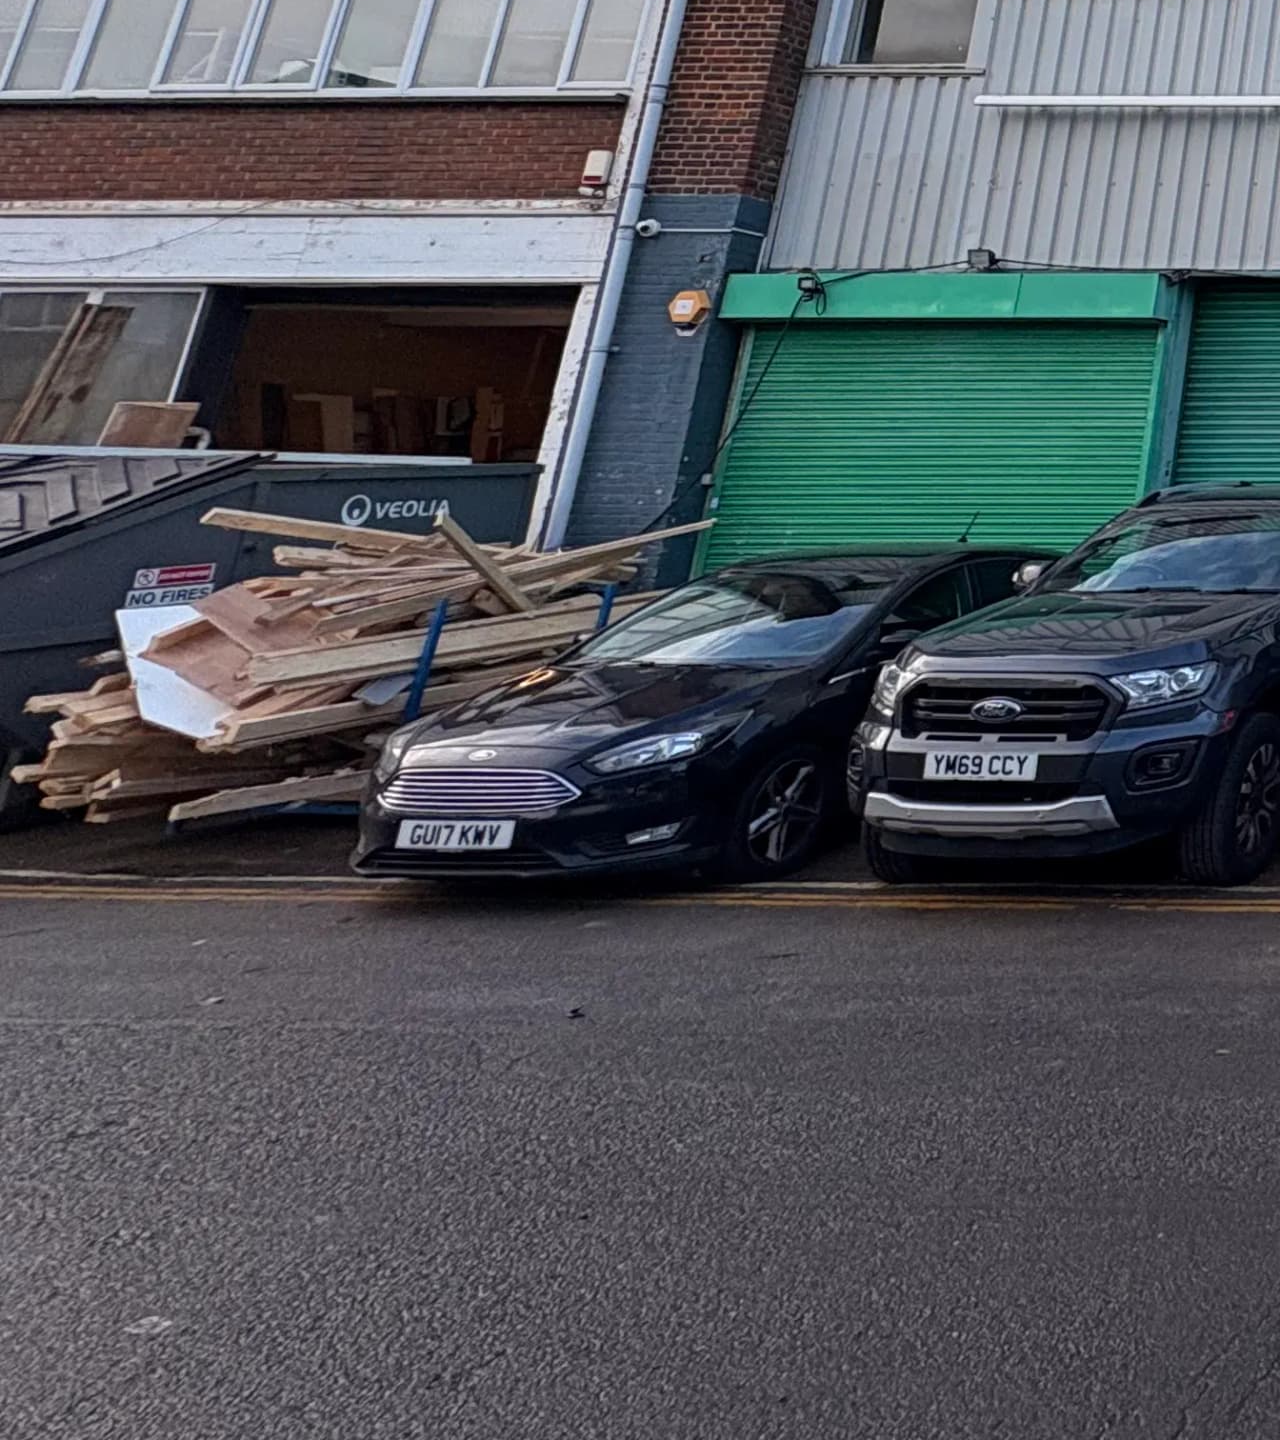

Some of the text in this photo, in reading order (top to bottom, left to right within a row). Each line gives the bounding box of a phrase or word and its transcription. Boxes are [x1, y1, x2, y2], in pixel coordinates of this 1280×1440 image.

[375, 499, 451, 520] VEOLIA
[127, 586, 211, 607] NO FIRES
[933, 754, 1029, 776] YM69 CCY
[410, 824, 502, 846] GU17 KWV
